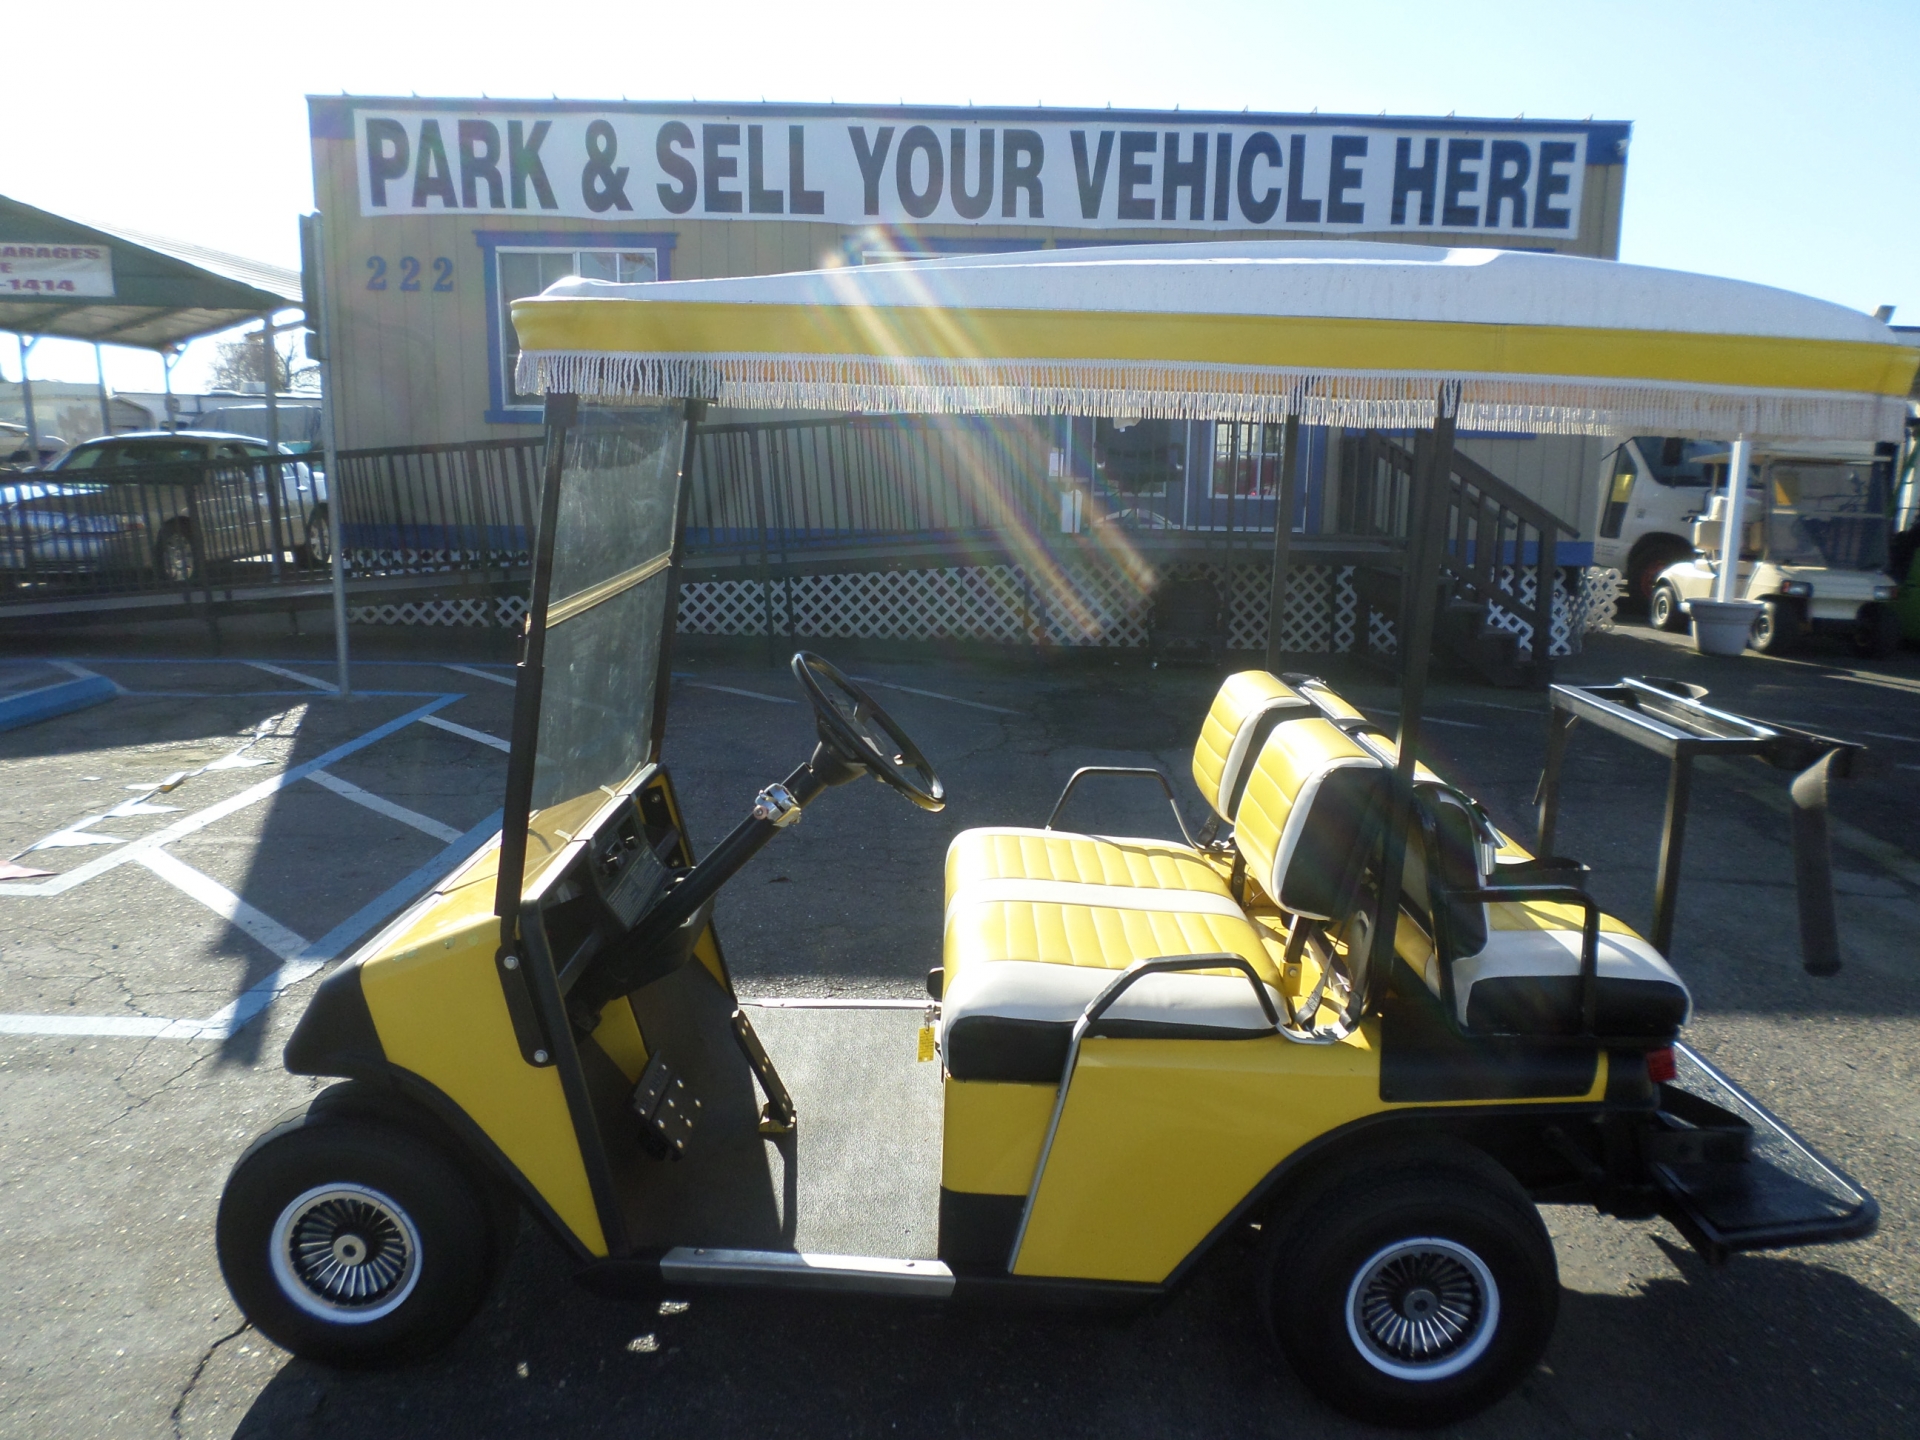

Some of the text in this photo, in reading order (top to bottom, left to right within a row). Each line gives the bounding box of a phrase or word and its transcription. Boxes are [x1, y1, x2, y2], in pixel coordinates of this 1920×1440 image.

[366, 118, 1577, 229] PARK & SELL YOUR VEHICLE HERE
[0, 246, 100, 260] ARAGES
[366, 255, 454, 292] 222
